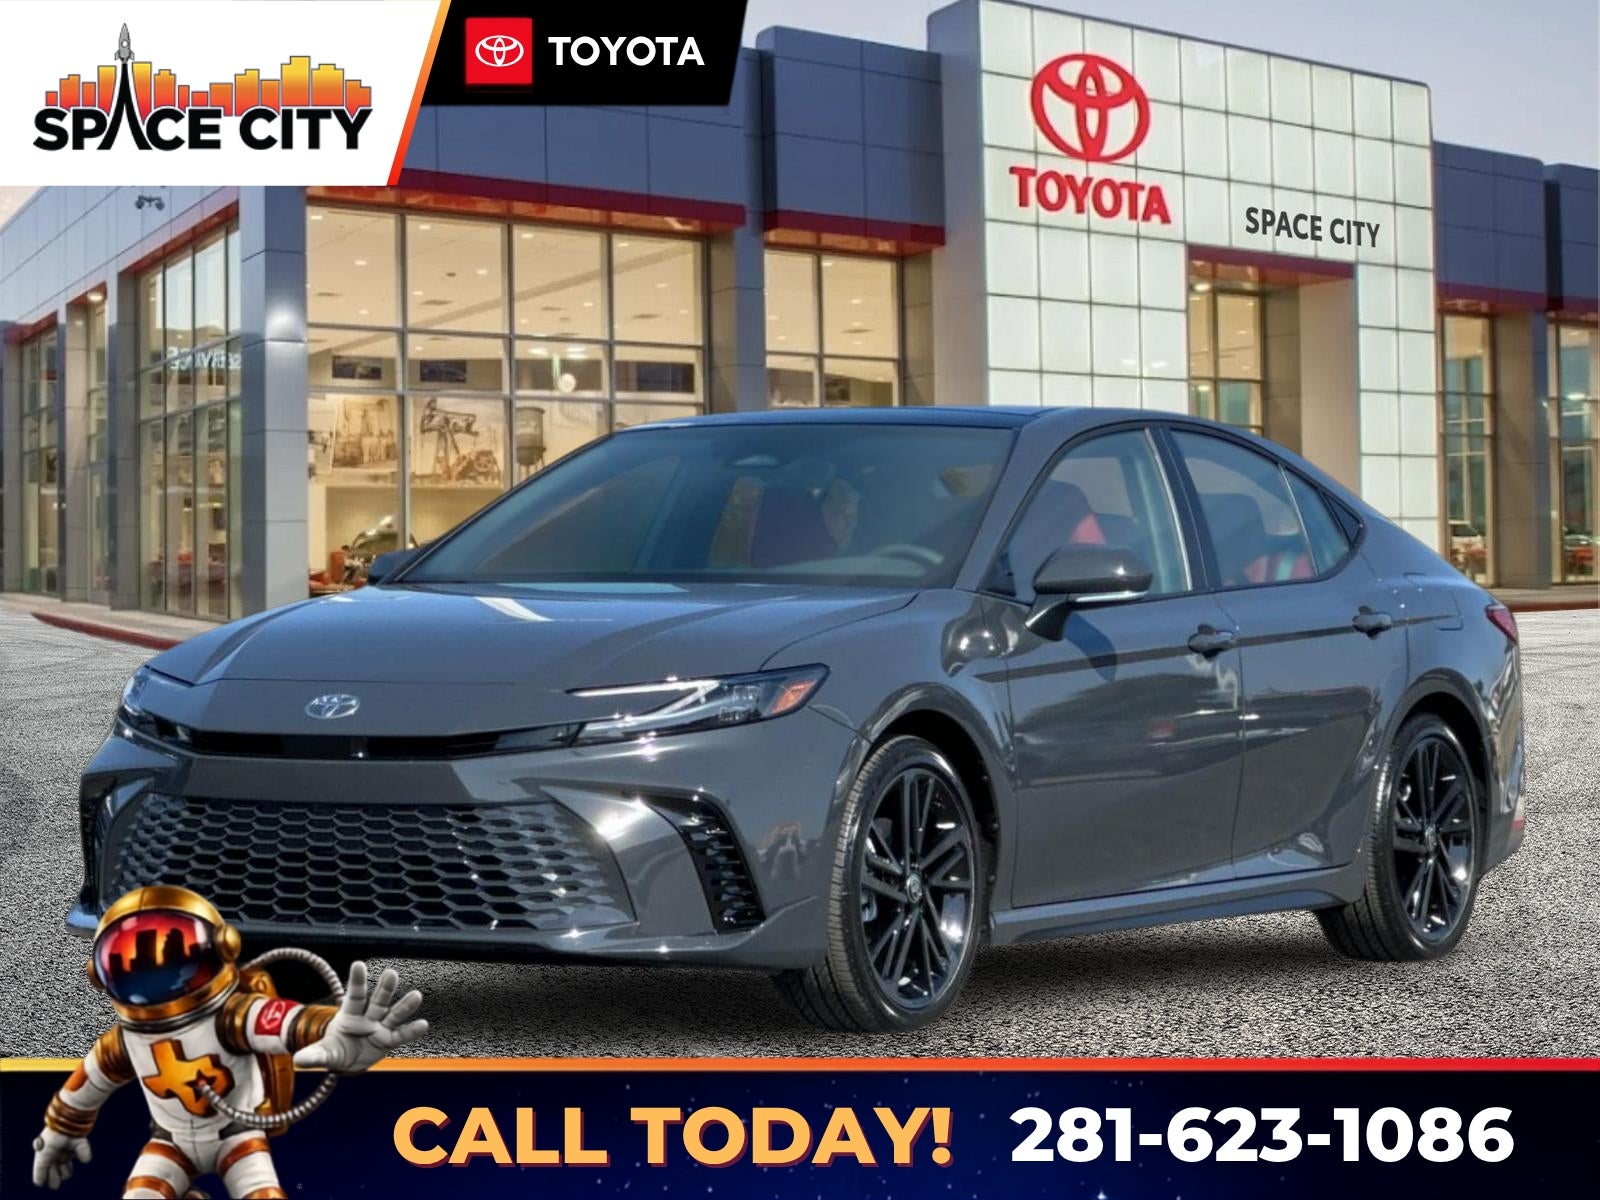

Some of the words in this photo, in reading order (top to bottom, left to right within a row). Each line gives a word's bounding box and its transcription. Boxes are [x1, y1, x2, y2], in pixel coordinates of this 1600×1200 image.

[1010, 166, 1171, 224] TOYOTA
[1245, 206, 1322, 242] SPACE
[1330, 218, 1381, 247] CITY
